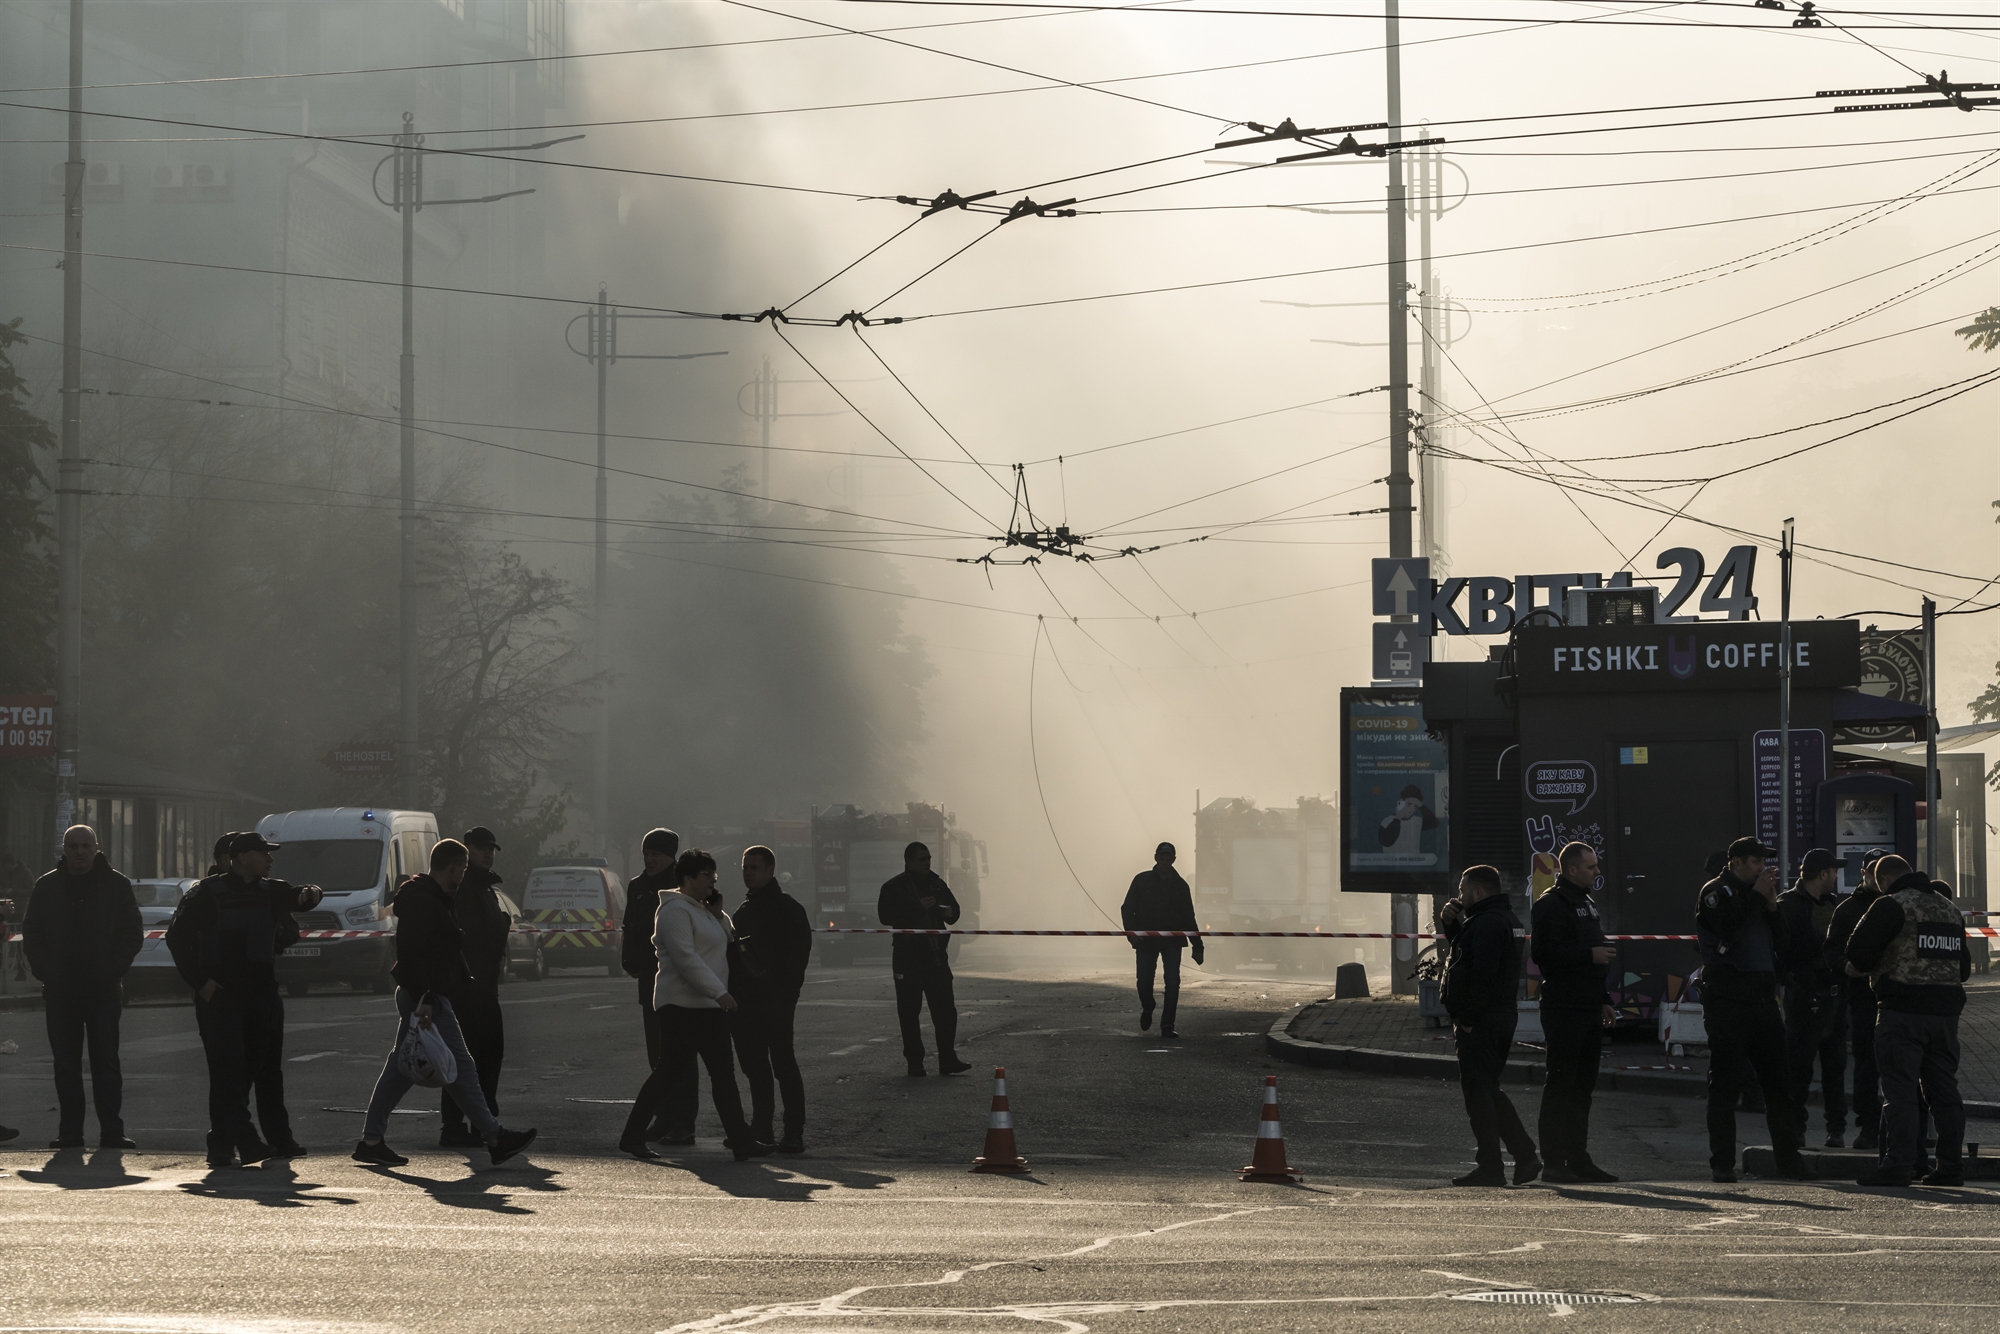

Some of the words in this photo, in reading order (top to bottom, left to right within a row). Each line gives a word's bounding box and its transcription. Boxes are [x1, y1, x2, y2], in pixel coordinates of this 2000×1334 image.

[1656, 546, 1758, 624] 24
[1554, 646, 1659, 672] FISHKI
[1356, 719, 1409, 729] COVID-19
[9, 730, 25, 746] 00
[29, 730, 53, 746] 957
[1356, 733, 1392, 743] нікуди
[1760, 738, 1779, 747] КАВА
[334, 751, 352, 761] THE
[353, 751, 393, 761] HOSTEL
[1537, 769, 1557, 781] ЯКУ
[1558, 769, 1585, 780] КАВУ
[1536, 783, 1586, 795] БАЖАЄТЕ?
[825, 853, 835, 864] 4
[1918, 934, 1961, 951] ПОЛІЦІЯ
